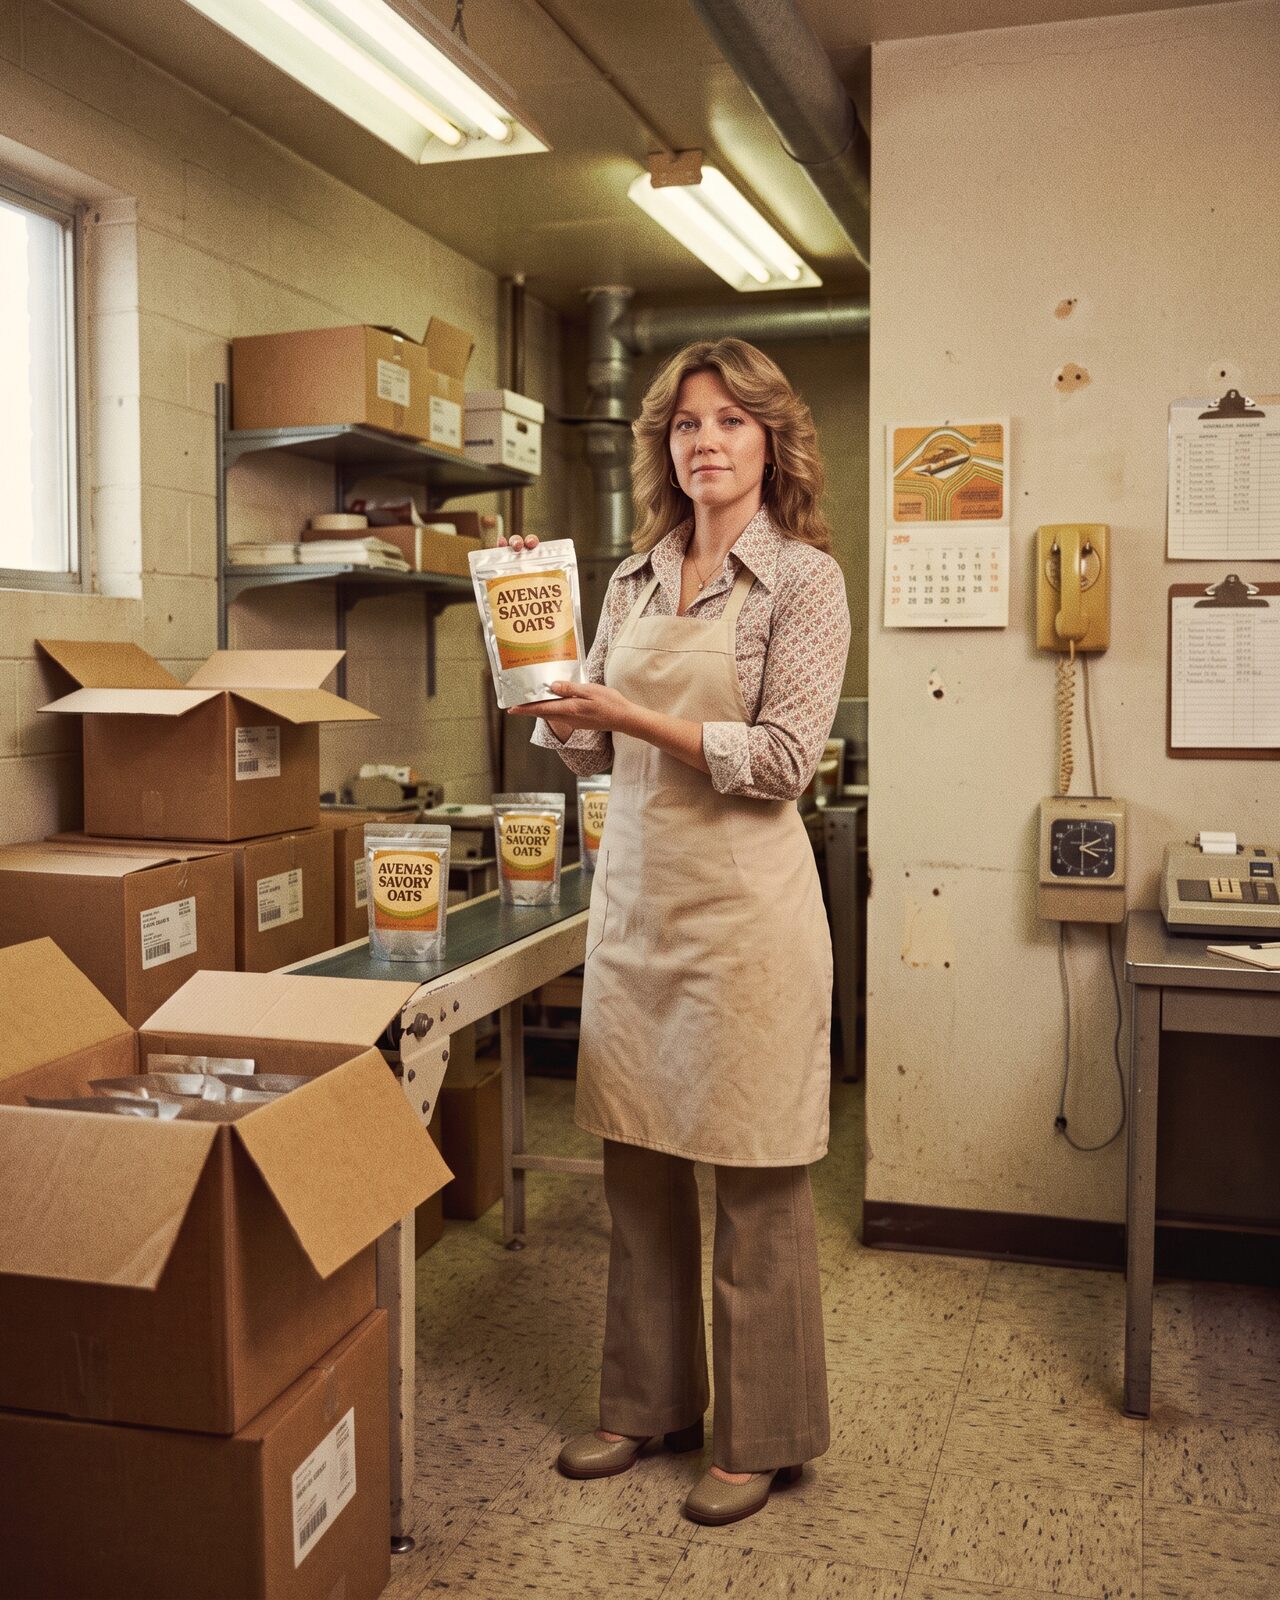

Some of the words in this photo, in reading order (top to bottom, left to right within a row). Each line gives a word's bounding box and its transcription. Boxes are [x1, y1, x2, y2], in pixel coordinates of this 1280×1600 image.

[496, 584, 562, 605] AVENA'S
[498, 600, 563, 620] SAVORY
[512, 616, 555, 633] OATS
[506, 824, 551, 835] AVENA'S
[506, 835, 550, 846] SAVORY
[512, 846, 542, 857] OATS
[378, 863, 433, 875] AVENA'S
[378, 876, 432, 888] SAVORY
[387, 889, 422, 902] OATS
